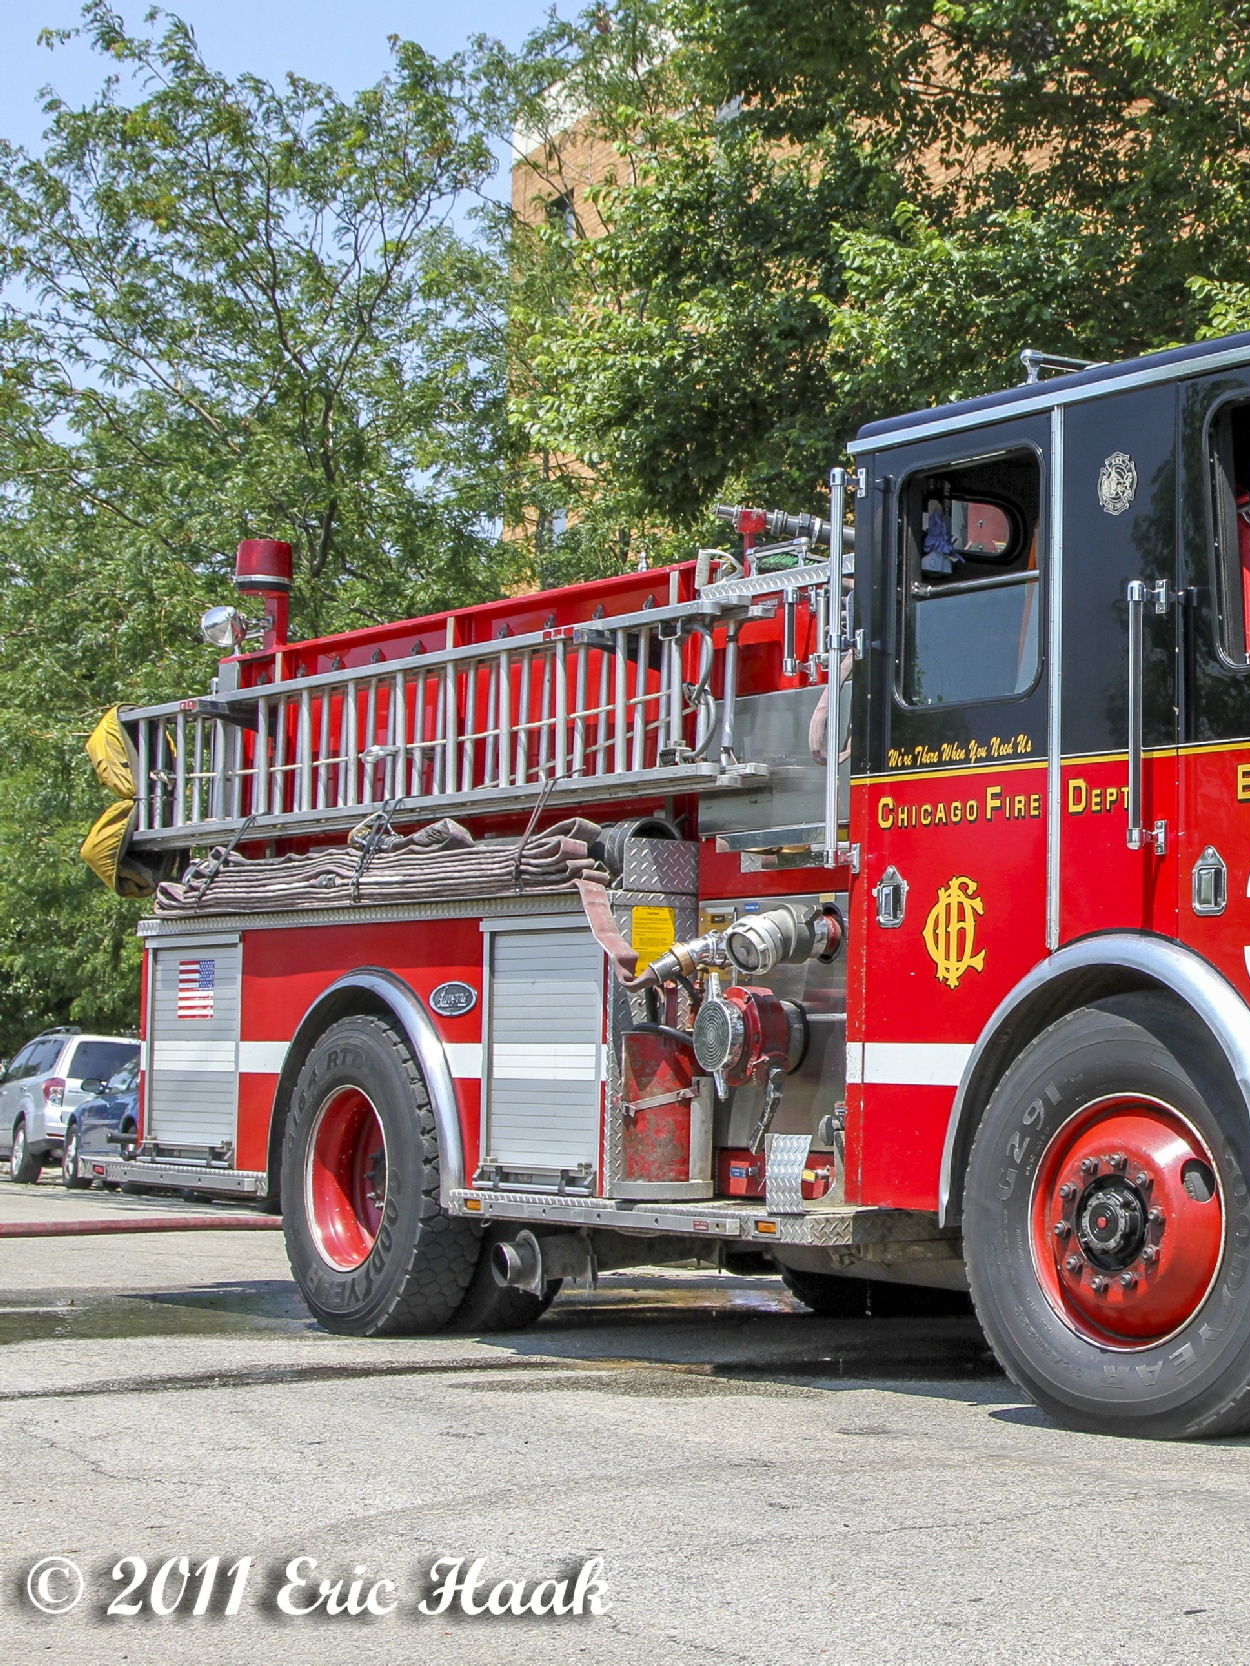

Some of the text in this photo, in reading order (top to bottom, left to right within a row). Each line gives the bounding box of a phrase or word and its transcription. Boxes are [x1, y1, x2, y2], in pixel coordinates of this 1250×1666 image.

[888, 734, 1032, 767] We're There When You Need Us
[877, 796, 979, 830] CHICAGO
[986, 785, 1042, 821] FIRE
[996, 1081, 1063, 1201] G291
